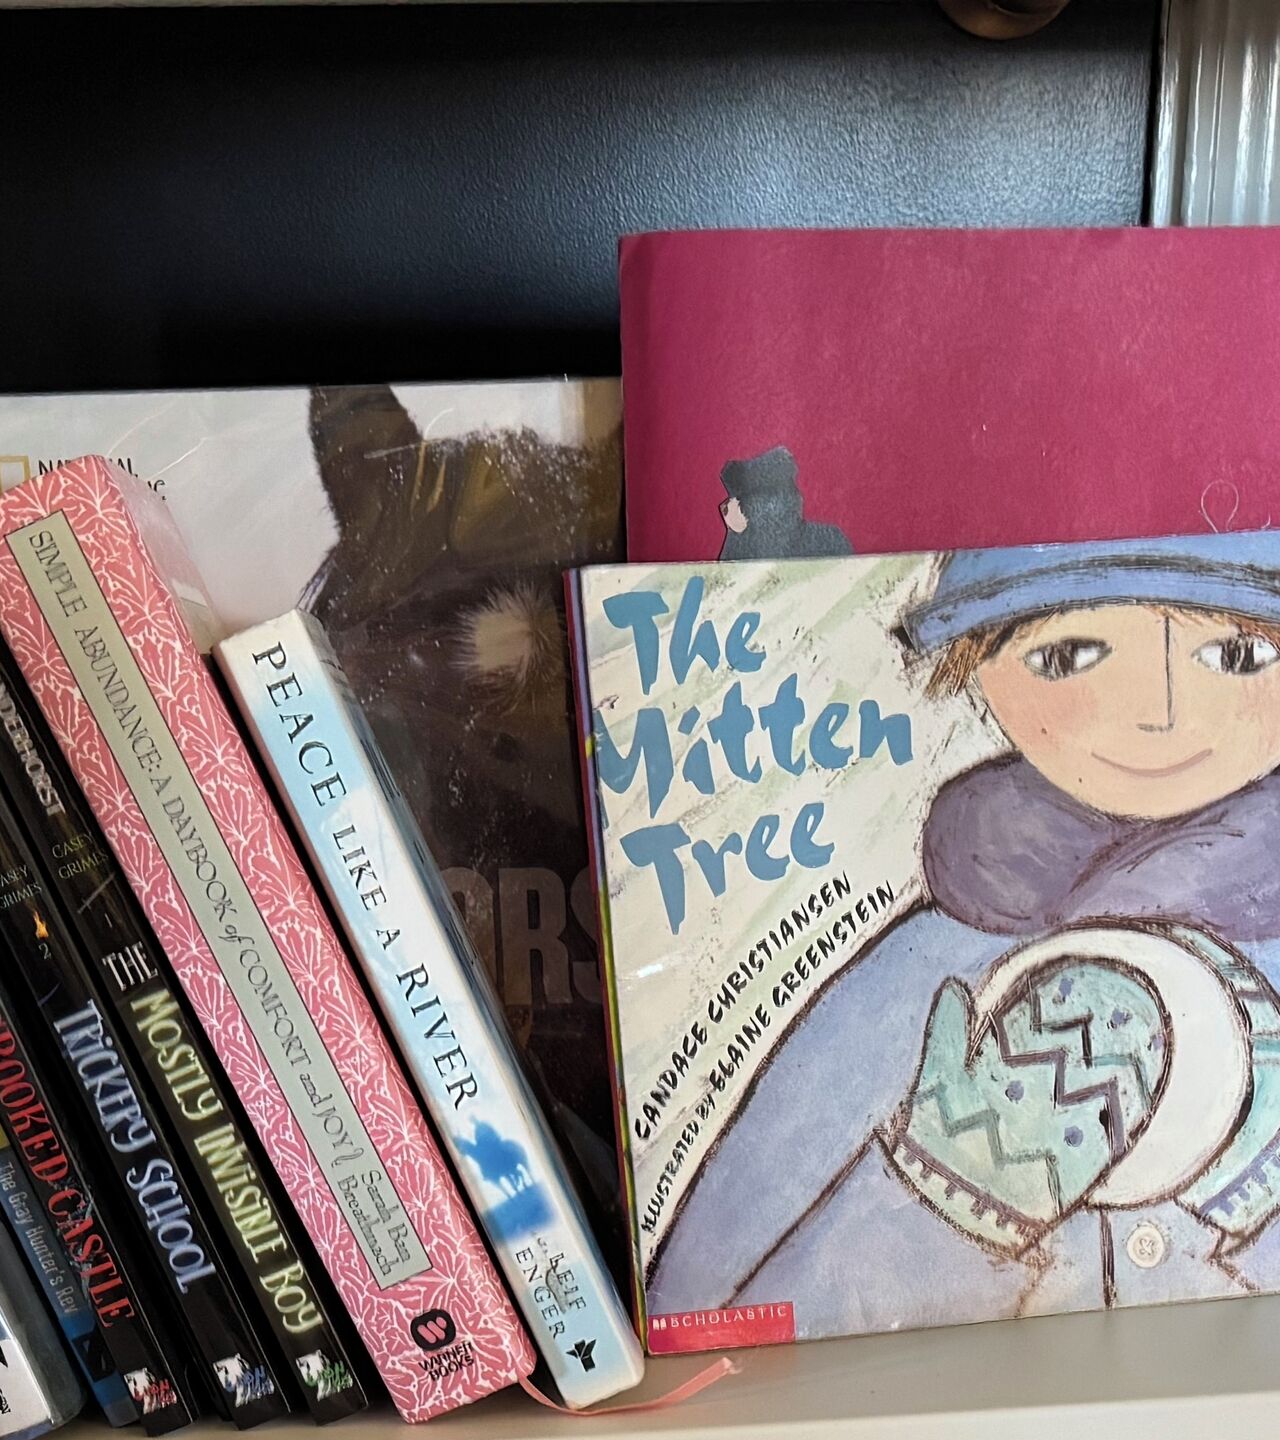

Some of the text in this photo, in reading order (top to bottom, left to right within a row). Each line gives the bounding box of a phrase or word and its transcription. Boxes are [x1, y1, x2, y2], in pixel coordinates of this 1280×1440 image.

[602, 575, 767, 696] The
[28, 528, 324, 1108] SIMPLE ABUNDANCE: A DAYBOOK of COMFORT and
[594, 671, 914, 834] Mitten
[250, 640, 483, 1111] PEACE LIKE A RIVER
[620, 797, 835, 937] Tree
[38, 942, 52, 960] 2
[101, 942, 159, 993] THE
[634, 871, 853, 1142] CANDACE CHRISTIANSEN
[709, 879, 898, 1093] ELAINE GREENSTEIN
[129, 986, 223, 1122] MOSTLY
[46, 1185, 137, 1330] CASTLE
[126, 1157, 219, 1294] SCHOOL
[361, 1169, 412, 1265] Sarah Ban
[417, 1340, 473, 1373] WARNER
[514, 1246, 566, 1341] ENGER
[669, 1305, 789, 1330] SCHOLASTIC
[428, 1355, 475, 1381] BOOKS
